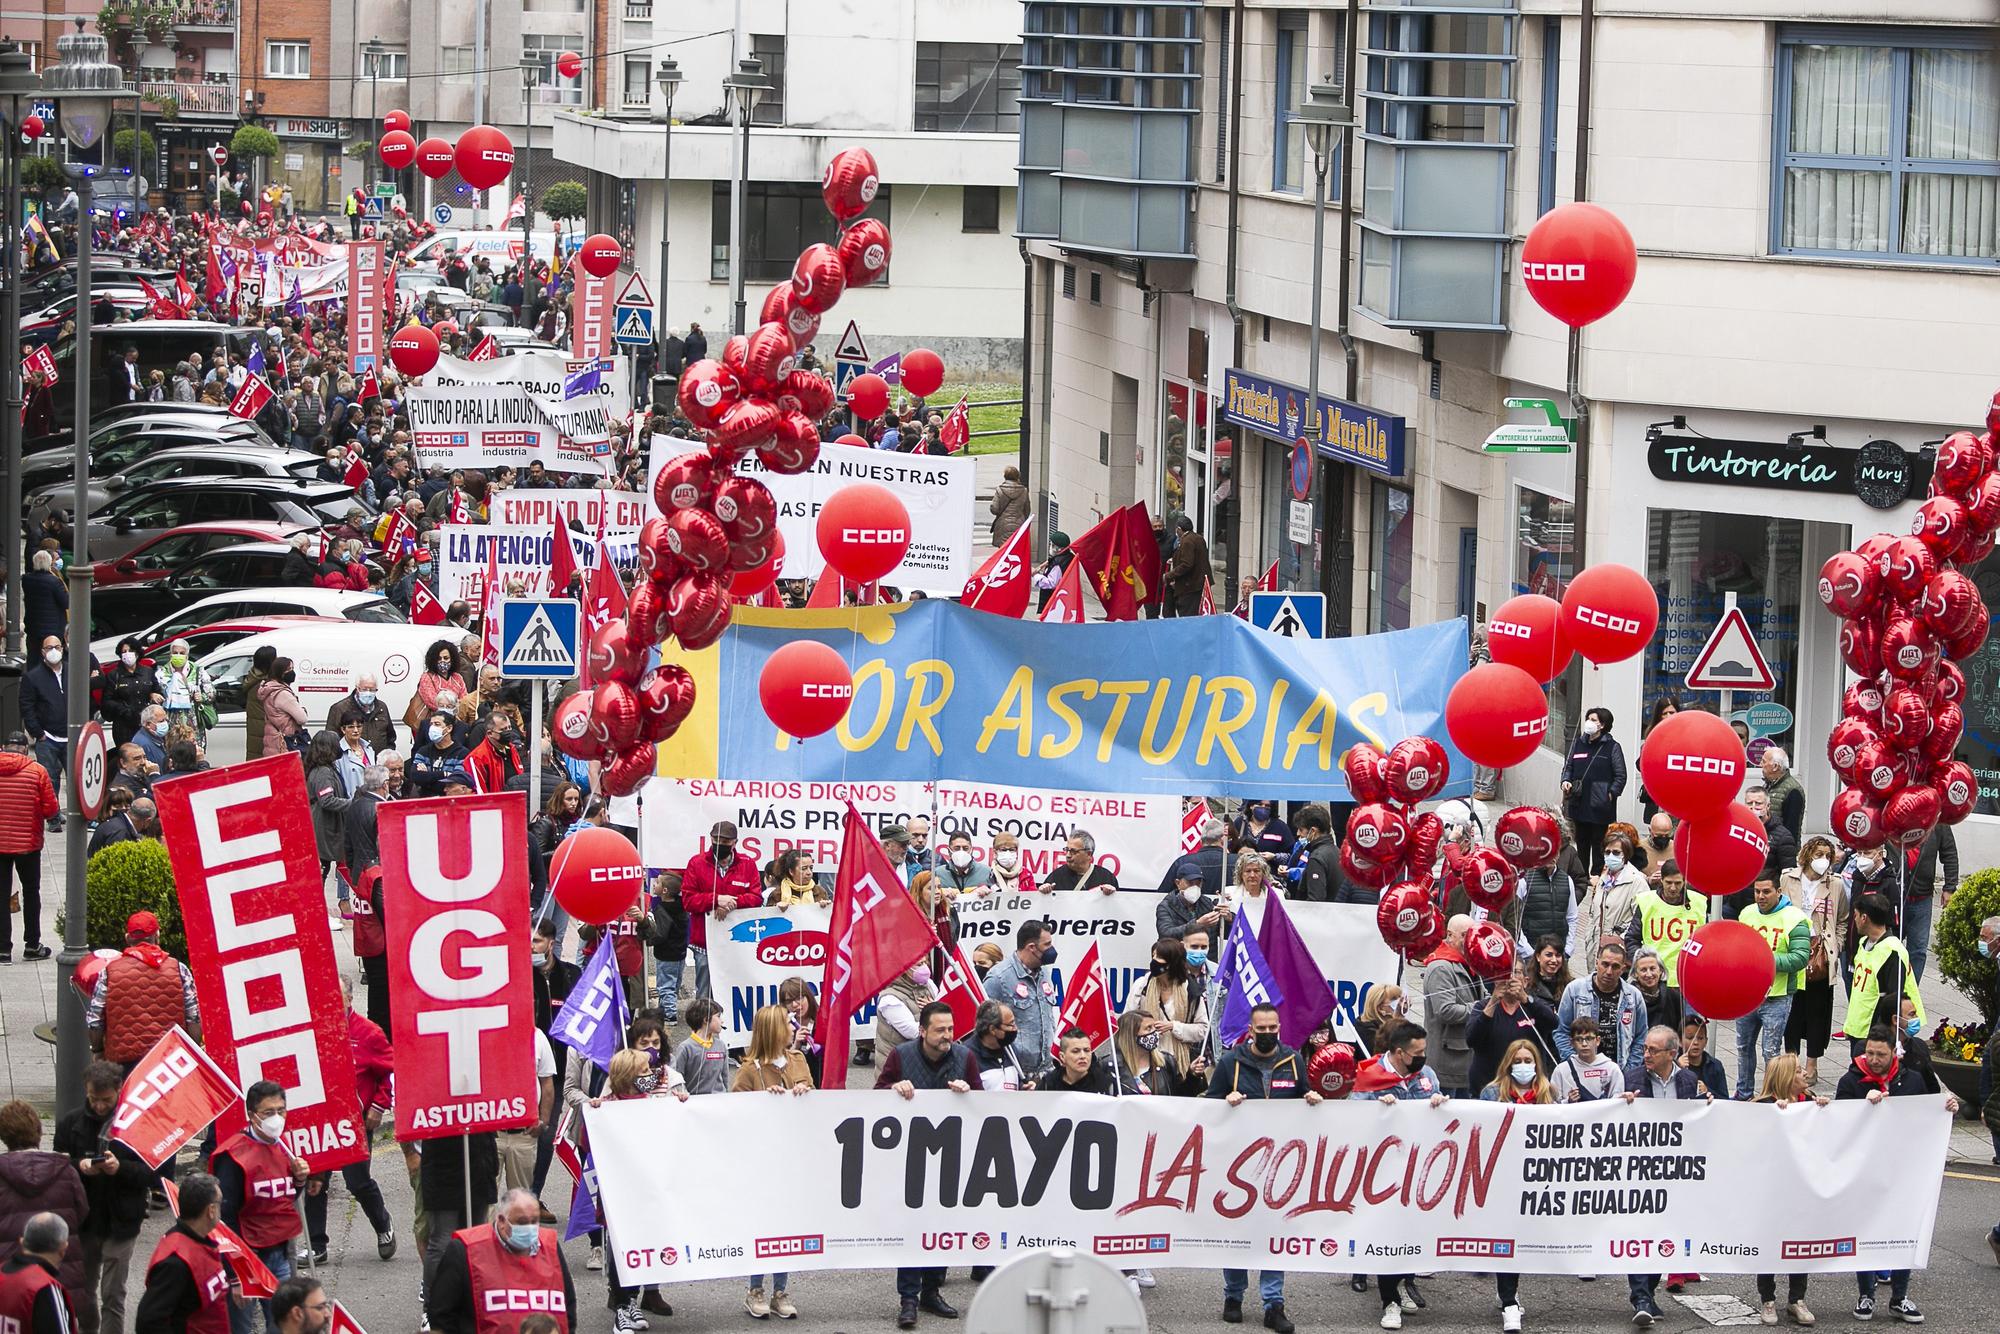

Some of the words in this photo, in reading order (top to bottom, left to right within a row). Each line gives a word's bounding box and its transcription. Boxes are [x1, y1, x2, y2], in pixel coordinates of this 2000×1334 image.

[384, 144, 406, 152] CCOO
[357, 270, 374, 353] CCOO
[233, 378, 260, 413] CCOO
[411, 399, 452, 424] FUTURO
[455, 399, 484, 424] PARA
[486, 399, 500, 424] LA
[485, 434, 525, 444] CCOO
[1327, 405, 1388, 462] Muralla
[483, 448, 527, 456] industria
[840, 462, 949, 486] NUESTRAS
[1664, 446, 1836, 482] Tintorería
[1861, 466, 1903, 484] Mery
[674, 487, 696, 498] UGT
[842, 529, 905, 543] CCOO
[449, 534, 471, 563] LA
[906, 551, 916, 559] de
[918, 550, 950, 562] Jóvenes
[908, 544, 950, 553] Colectivos
[903, 561, 949, 571] Comunistas
[1488, 621, 1531, 639] CCOO
[1576, 605, 1640, 635] CCOO
[313, 668, 349, 676] Schindler
[803, 684, 852, 698] CCOO
[976, 665, 1389, 774] ASTURIAS
[86, 754, 102, 789] 30
[1667, 755, 1735, 775] CCOO
[690, 780, 802, 800] SALARIOS
[810, 784, 897, 802] DIGNOS
[940, 789, 1043, 814] TRABAJO
[1050, 796, 1147, 819] ESTABLE
[739, 804, 797, 833] MÁS
[1358, 831, 1375, 845] UGT
[1503, 839, 1521, 850] UGT
[590, 866, 643, 882] CCOO
[1482, 872, 1502, 886] UGT
[1006, 896, 1032, 911] de
[1651, 919, 1698, 943] UGT
[405, 809, 510, 1097] UGT
[112, 1047, 199, 1131] CCOO
[411, 1097, 526, 1131] ASTURIAS
[1524, 1123, 1584, 1150] SUBIR
[1590, 1121, 1684, 1148] SALARIOS
[1116, 1124, 1208, 1218] LA
[1213, 1107, 1515, 1220] SOLUCIÓN
[1522, 1156, 1621, 1183] CONTENER
[1626, 1155, 1707, 1182] PRECIOS
[1519, 1185, 1566, 1216] MÁS
[1571, 1188, 1668, 1216] IGUALDAD
[697, 1245, 745, 1260] Asturias
[758, 1241, 802, 1257] CCOO
[921, 1232, 968, 1251] UGT
[1097, 1238, 1148, 1253] CCOO
[1269, 1237, 1317, 1255] UGT
[1364, 1243, 1422, 1257] Asturias
[1441, 1240, 1490, 1253] CCOO
[1609, 1239, 1654, 1258] UGT
[1699, 1240, 1760, 1257] Asturias
[1785, 1242, 1834, 1257] CCOO
[485, 1289, 567, 1312] CCOO
